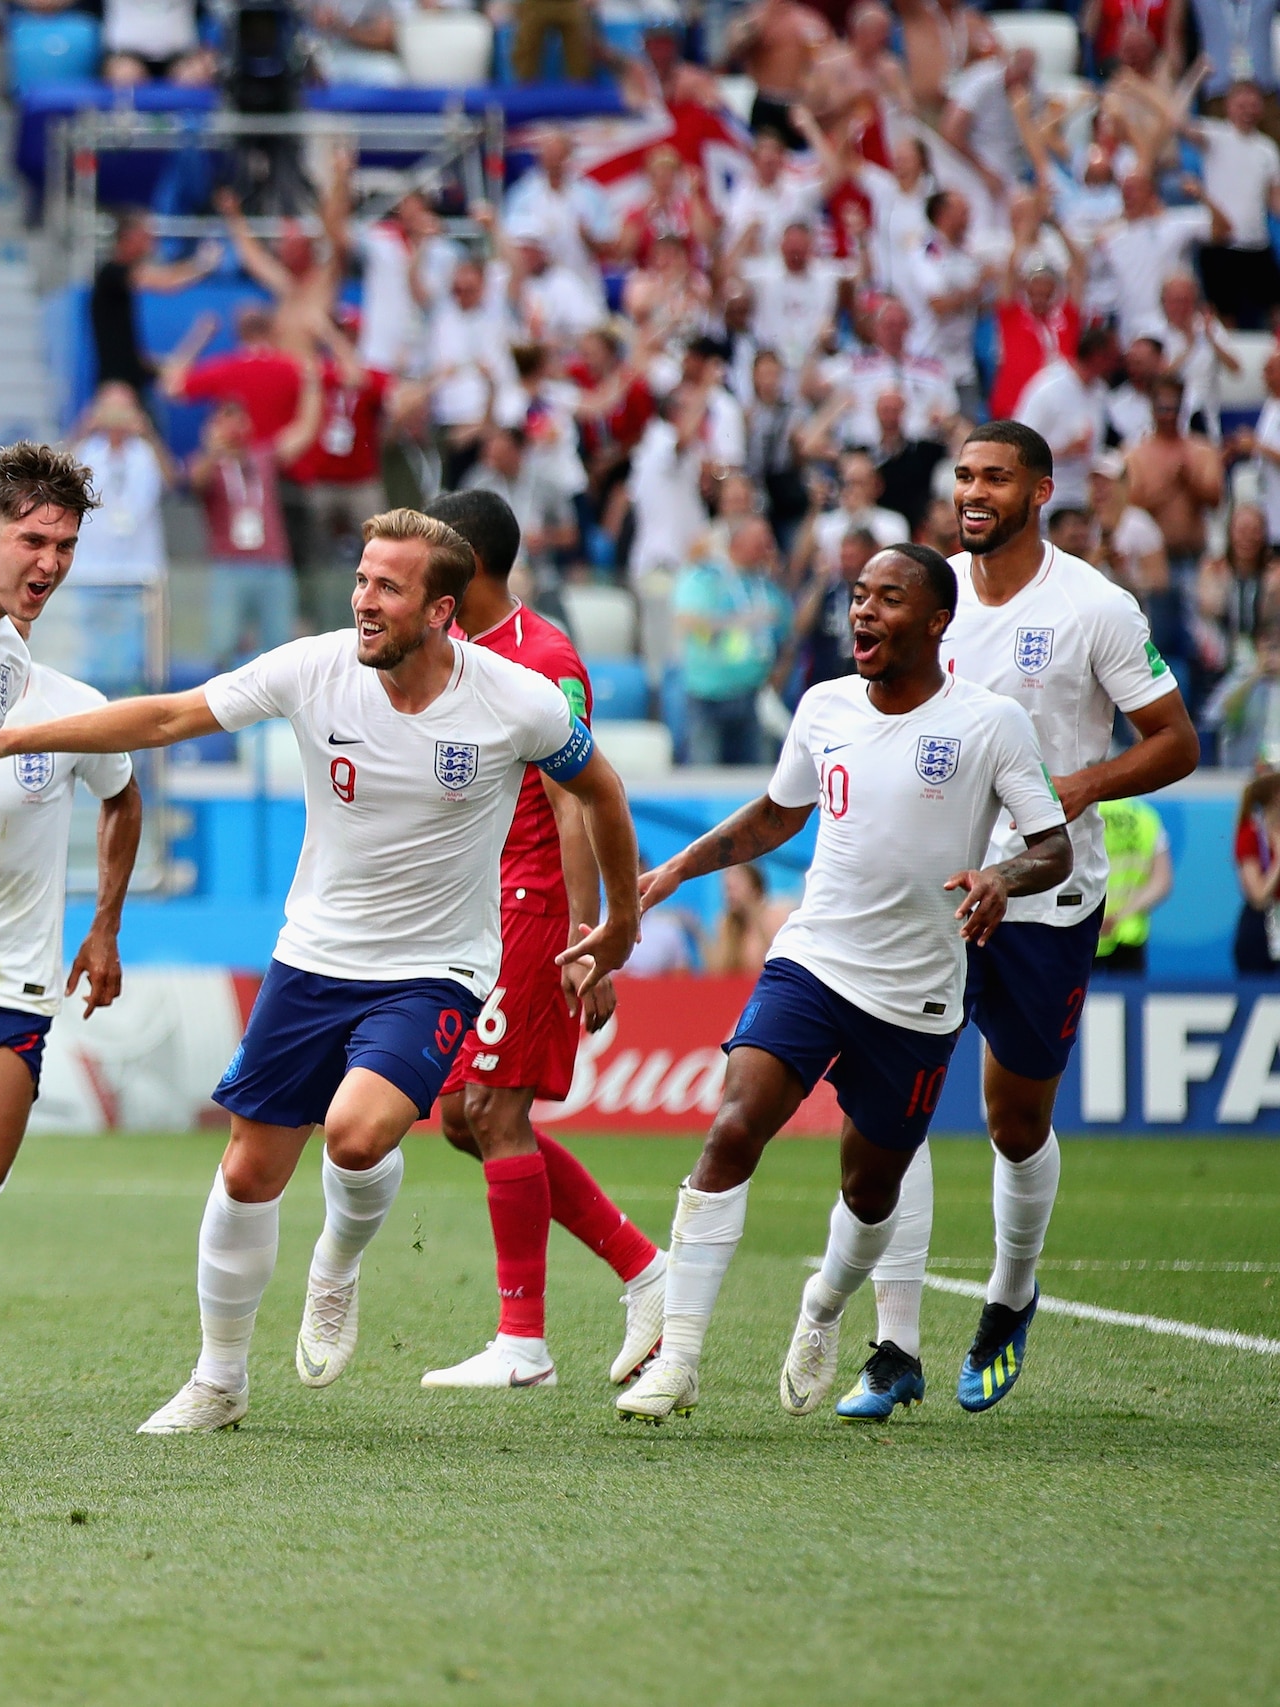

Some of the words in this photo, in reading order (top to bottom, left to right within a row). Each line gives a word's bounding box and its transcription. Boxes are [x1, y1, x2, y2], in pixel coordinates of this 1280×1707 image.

[577, 738, 591, 762] FIFA
[329, 756, 356, 803] 9
[434, 1008, 463, 1055] 9
[476, 986, 507, 1045] 6
[978, 993, 1280, 1123] IFA
[905, 1065, 947, 1117] 10
